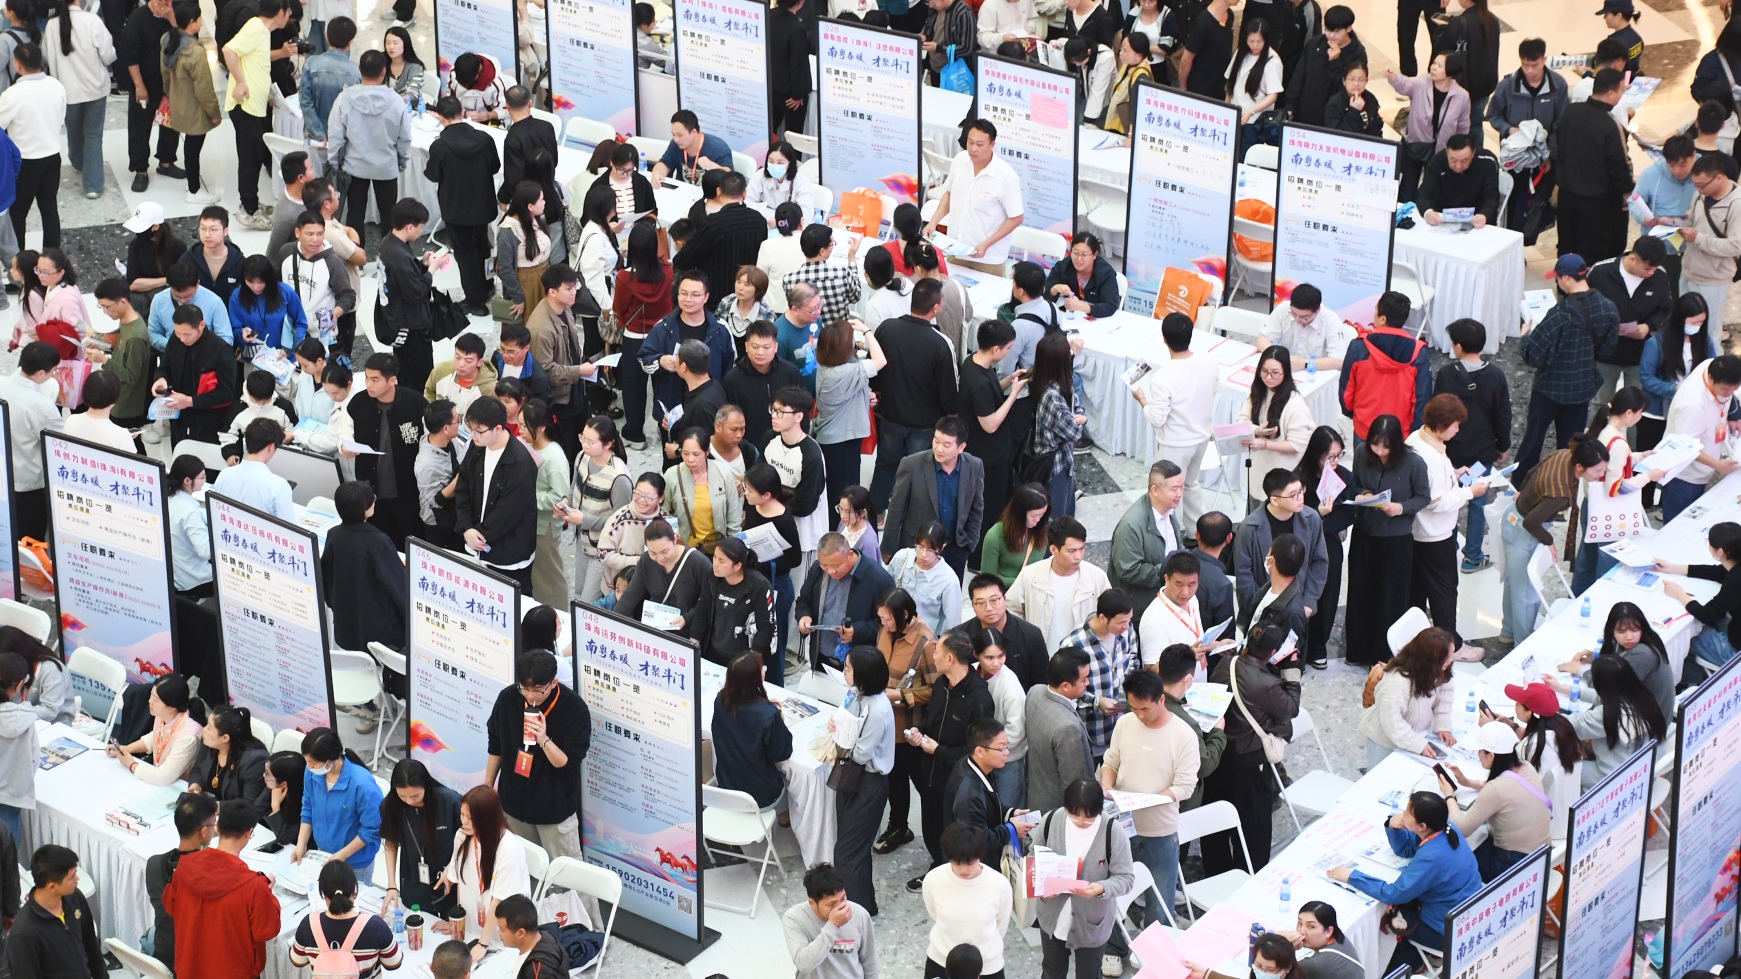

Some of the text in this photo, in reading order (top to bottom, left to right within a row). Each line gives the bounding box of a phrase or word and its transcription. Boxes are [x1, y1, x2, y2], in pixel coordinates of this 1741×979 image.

[683, 9, 759, 39] 南粤春暖 才聚斗门
[824, 25, 839, 33] 028
[569, 37, 596, 50] 任职要求
[682, 29, 726, 46] 招聘岗位一览
[827, 46, 910, 77] 南粤春暖 才聚斗门
[983, 60, 998, 70] 030
[699, 70, 727, 85] 任职要求
[826, 67, 873, 83] 招聘岗位一览
[986, 82, 1025, 102] 南粤春暖
[1144, 88, 1159, 98] 032
[843, 107, 873, 121] 任职要求
[1144, 111, 1228, 146] 南粤春暖 才聚斗门
[1290, 130, 1306, 140] 034
[1141, 133, 1189, 153] 招聘岗位一览
[1000, 147, 1030, 160] 任职要求
[1291, 152, 1386, 178] 南粤春暖 才聚斗门
[1154, 179, 1186, 194] 任职要求
[1287, 174, 1342, 193] 招聘岗位一览
[1304, 220, 1338, 234] 任职要求
[52, 439, 69, 450] 042
[57, 465, 154, 510] 南粤春暖 才聚斗门
[56, 489, 113, 514] 招聘岗位一览
[216, 502, 231, 513] 044
[80, 542, 116, 561] 任职要求
[221, 528, 308, 577] 南粤春暖 才聚斗门
[416, 547, 431, 561] 046
[221, 552, 271, 581] 招聘岗位一览
[418, 575, 507, 629] 南粤春暖 才聚斗门
[243, 607, 275, 627] 任职要求
[416, 601, 468, 632] 招聘岗位一览
[582, 610, 599, 624] 048
[434, 659, 467, 680] 任职要求
[585, 639, 685, 691] 南粤春暖 才聚斗门
[89, 679, 117, 695] 135
[584, 663, 641, 695] 招聘岗位一览
[605, 721, 641, 741] 任职要求
[1683, 737, 1718, 774] 招聘岗位一览
[1692, 789, 1715, 817] 任职要求
[1575, 782, 1644, 854] 南粤春暖 才聚斗门
[1572, 837, 1612, 876] 招聘岗位一览
[605, 863, 675, 900] 15902031454
[1581, 889, 1607, 919] 任职要求
[1456, 910, 1471, 928] 062
[1456, 890, 1537, 965] 南粤春暖 才聚斗门
